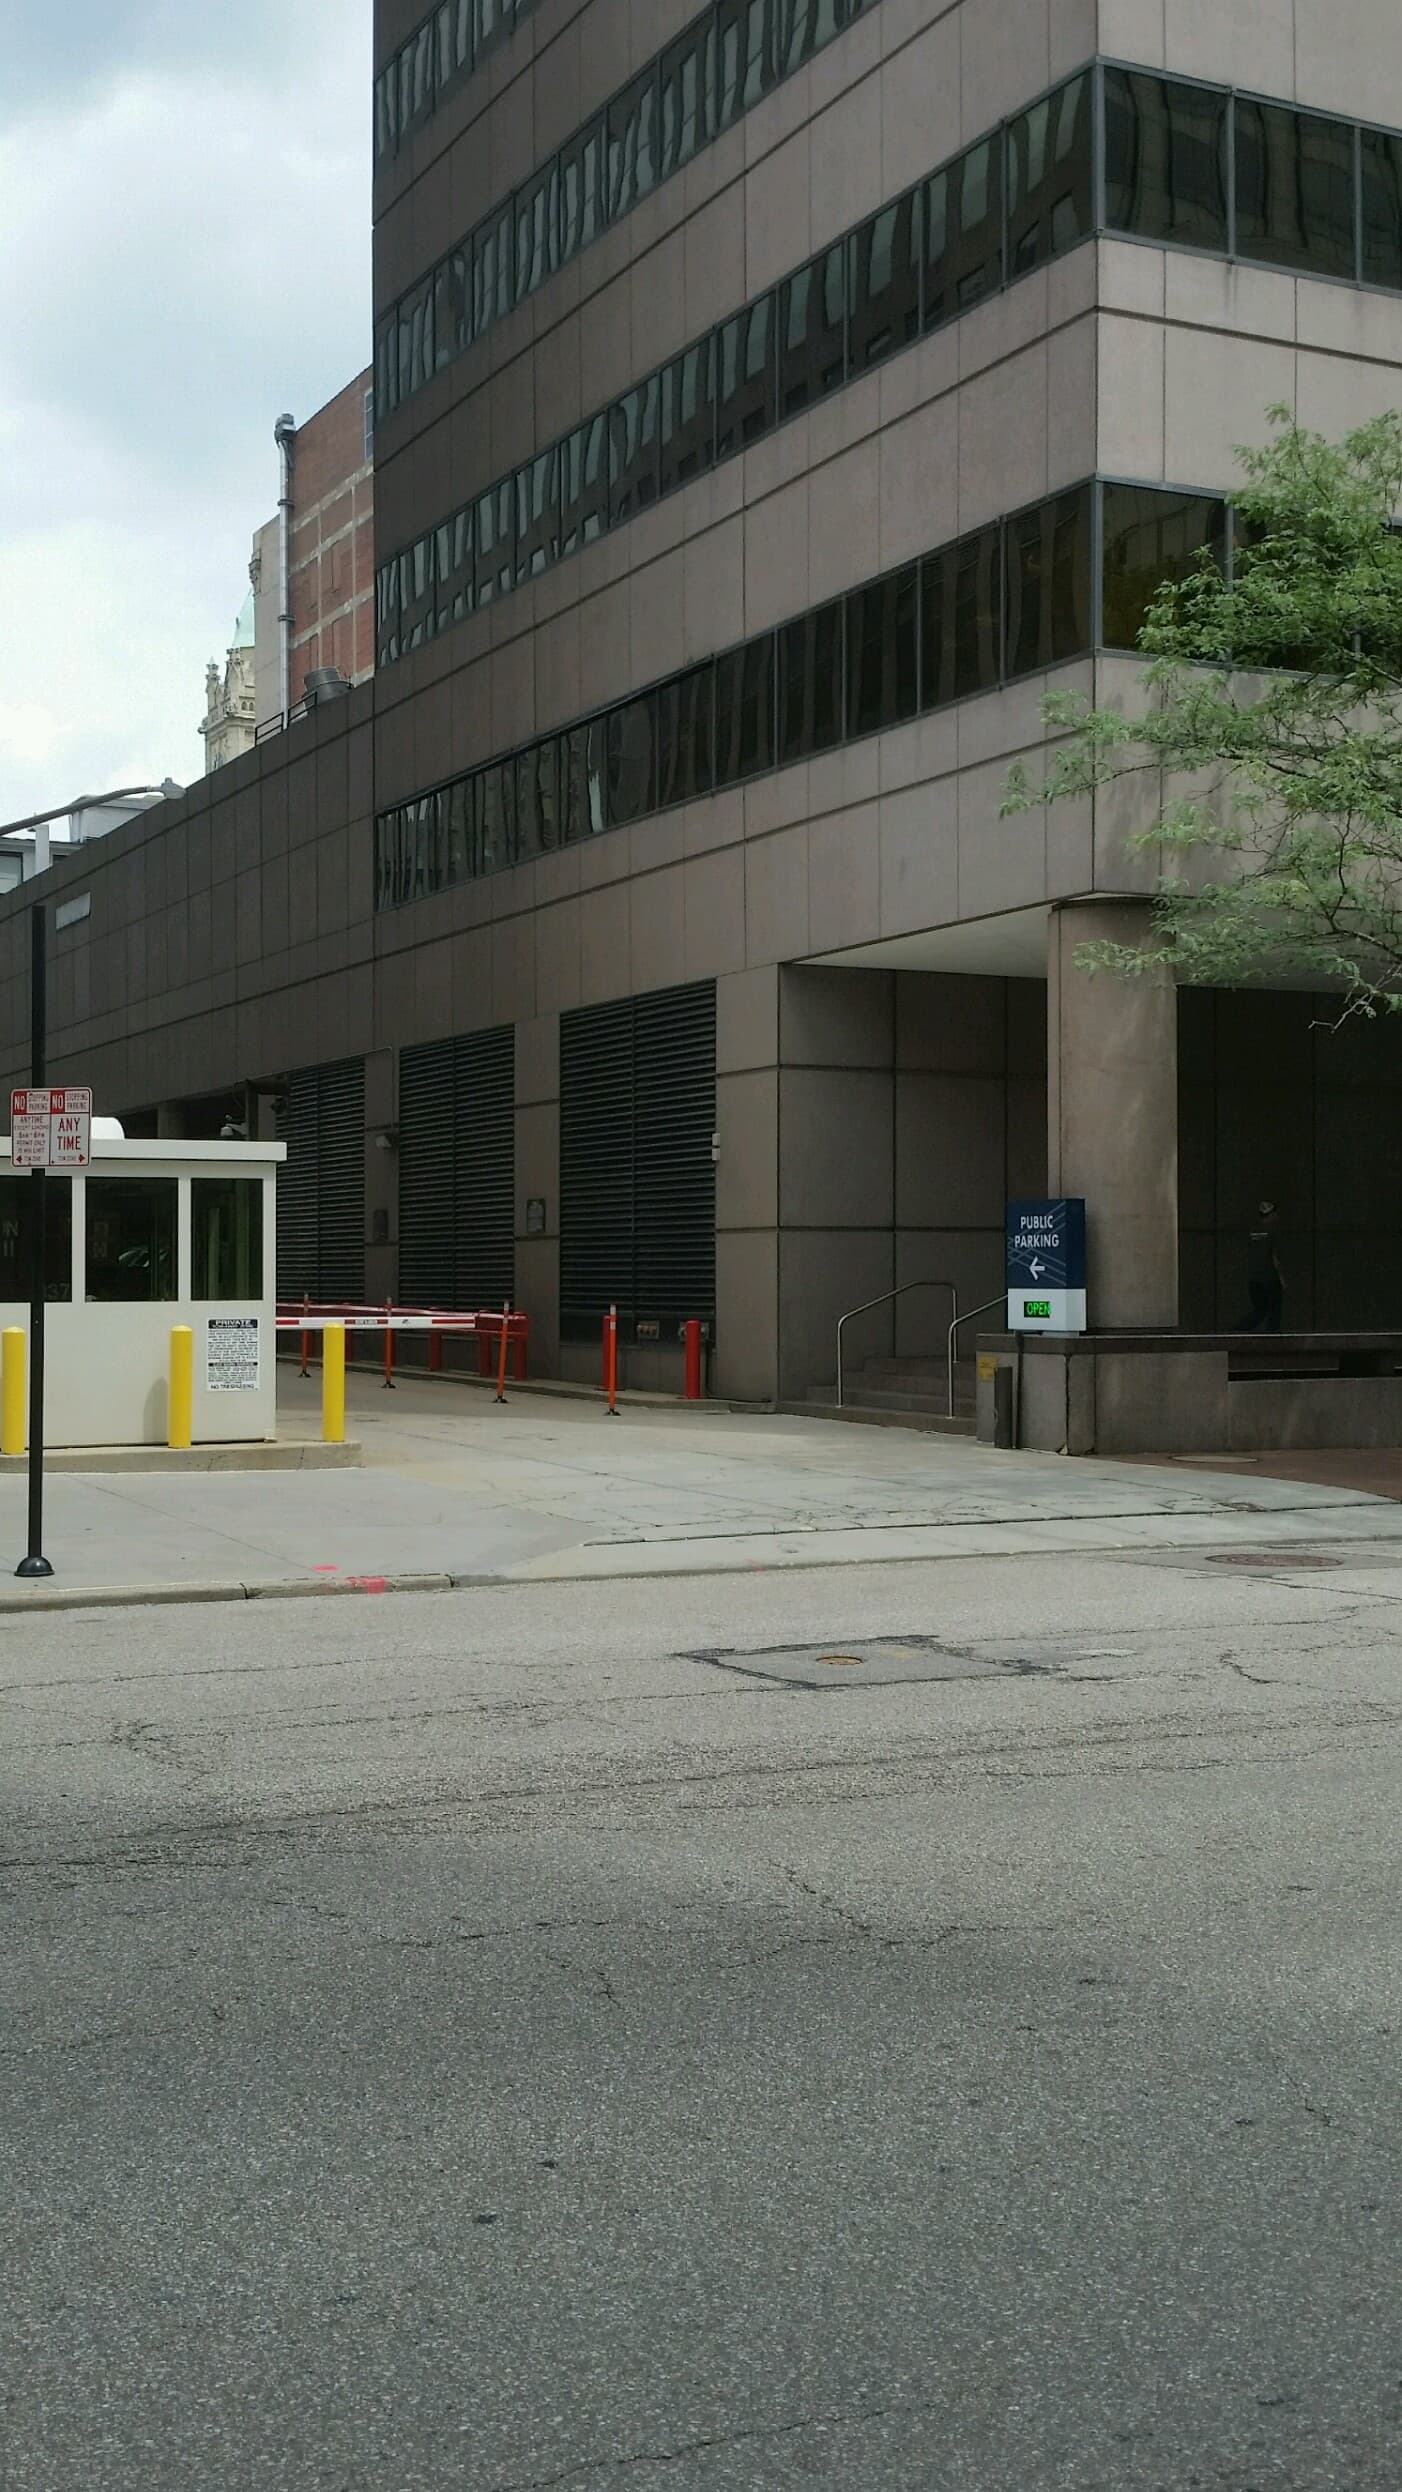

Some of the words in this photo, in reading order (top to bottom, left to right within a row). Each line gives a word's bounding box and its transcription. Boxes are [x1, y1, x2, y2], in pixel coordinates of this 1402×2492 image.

[14, 1095, 26, 1111] NO
[52, 1095, 64, 1110] NO
[66, 1102, 88, 1110] PARKING
[58, 1117, 80, 1132] ANY
[57, 1135, 82, 1151] TIME
[1020, 1215, 1054, 1229] PUBLIC
[1014, 1234, 1060, 1248] PARKING
[1026, 1302, 1052, 1316] OPEN
